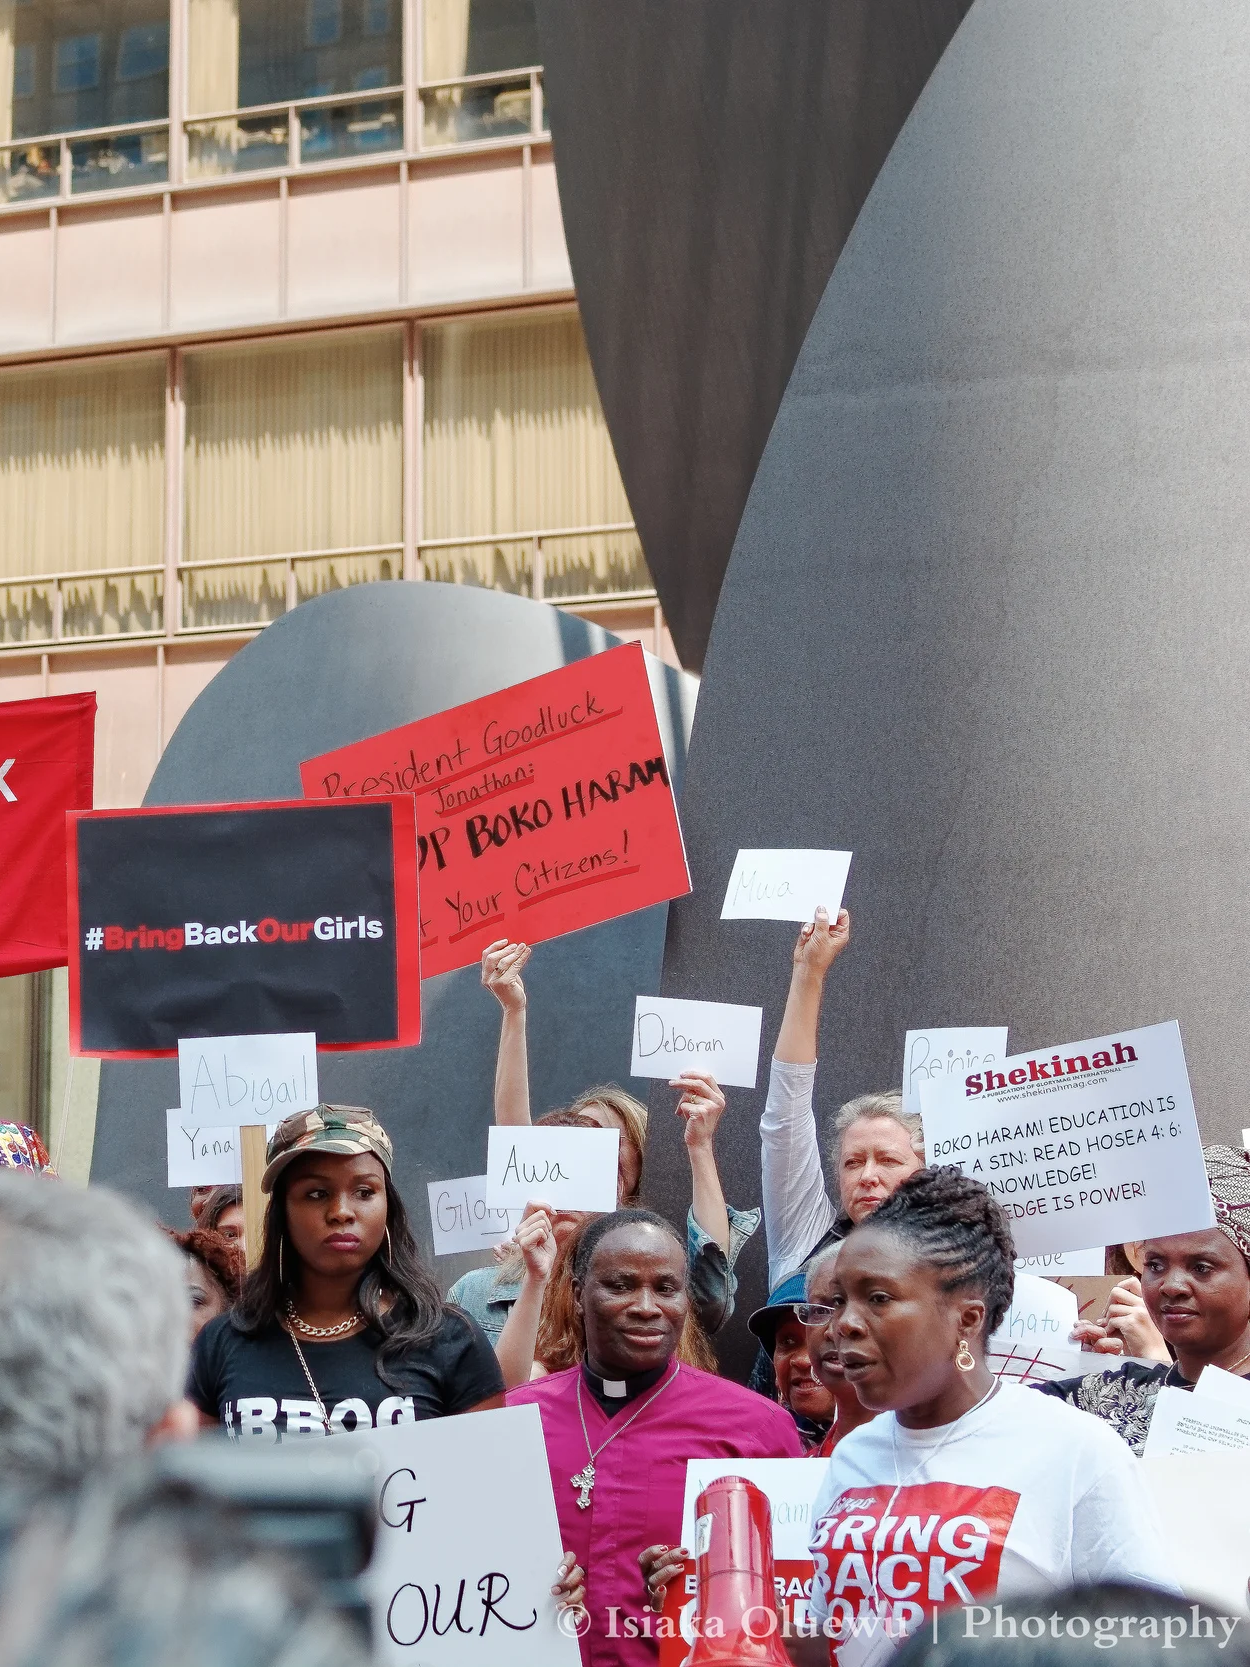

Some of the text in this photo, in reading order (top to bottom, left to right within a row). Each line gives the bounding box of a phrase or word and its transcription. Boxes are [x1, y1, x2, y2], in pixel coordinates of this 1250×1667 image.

[321, 690, 605, 797] President Goodluck
[465, 798, 554, 859] BOKO
[444, 828, 629, 931] Your Citizens!
[84, 915, 384, 952] #BringBackOurGirls
[190, 1053, 308, 1116] Abigail
[964, 1042, 1139, 1098] Shekinah
[987, 1085, 1026, 1098] PUBLICATION
[1035, 1077, 1072, 1088] GLORYMAG
[1072, 1067, 1122, 1080] INTERNATIONAL
[997, 1076, 1108, 1104] www.shekinahmag.com
[180, 1125, 235, 1160] Yana
[933, 1095, 1176, 1158] BOKO HARAM! EDUCATION IS
[972, 1158, 984, 1173] A
[989, 1150, 1028, 1170] SIN:
[1033, 1141, 1081, 1162] READ
[1086, 1128, 1147, 1153] HOSEA
[502, 1145, 570, 1186] Awa
[1052, 1194, 1075, 1212] IS
[1079, 1180, 1147, 1207] POWER!
[807, 1514, 991, 1562] BRING
[814, 1552, 983, 1605] BACK
[386, 1571, 538, 1647] OUR
